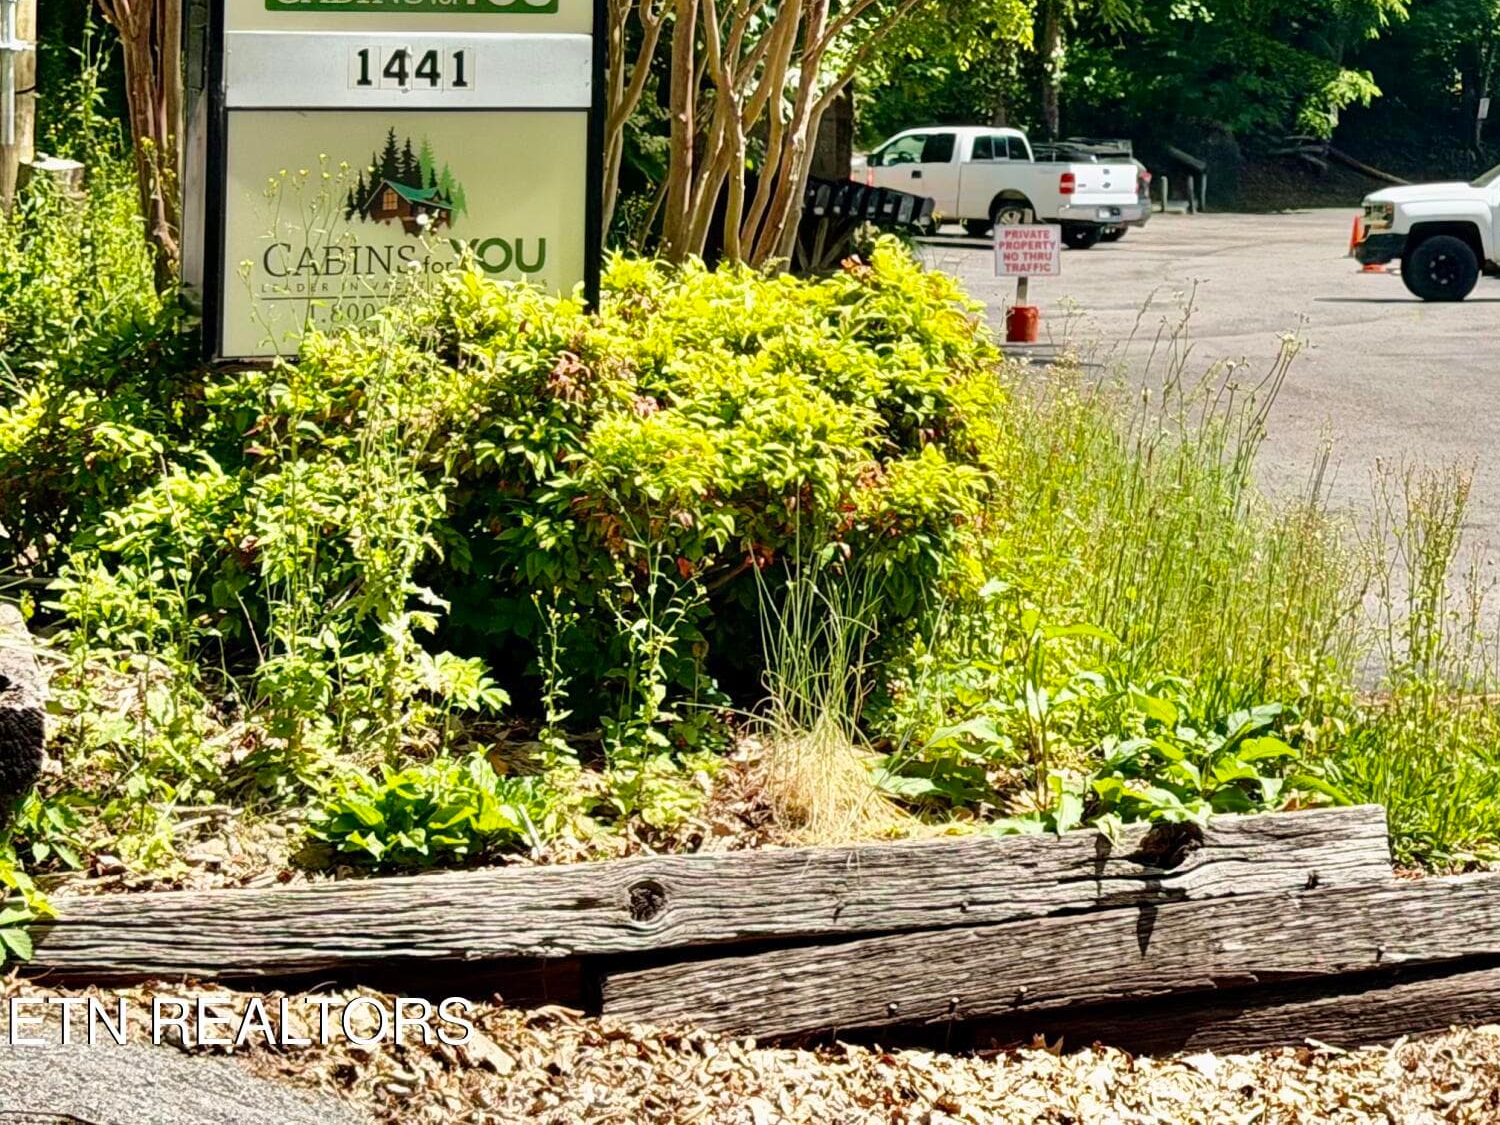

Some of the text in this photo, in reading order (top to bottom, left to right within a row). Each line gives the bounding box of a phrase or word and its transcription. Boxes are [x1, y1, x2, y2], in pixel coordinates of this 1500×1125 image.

[356, 48, 469, 88] 1441
[1004, 229, 1050, 239] PRIVATE
[999, 241, 1056, 250] PROPERTY
[263, 237, 546, 277] CABINS for YOU
[1003, 252, 1052, 261] NO THRU
[1004, 262, 1051, 272] TRAFFIC
